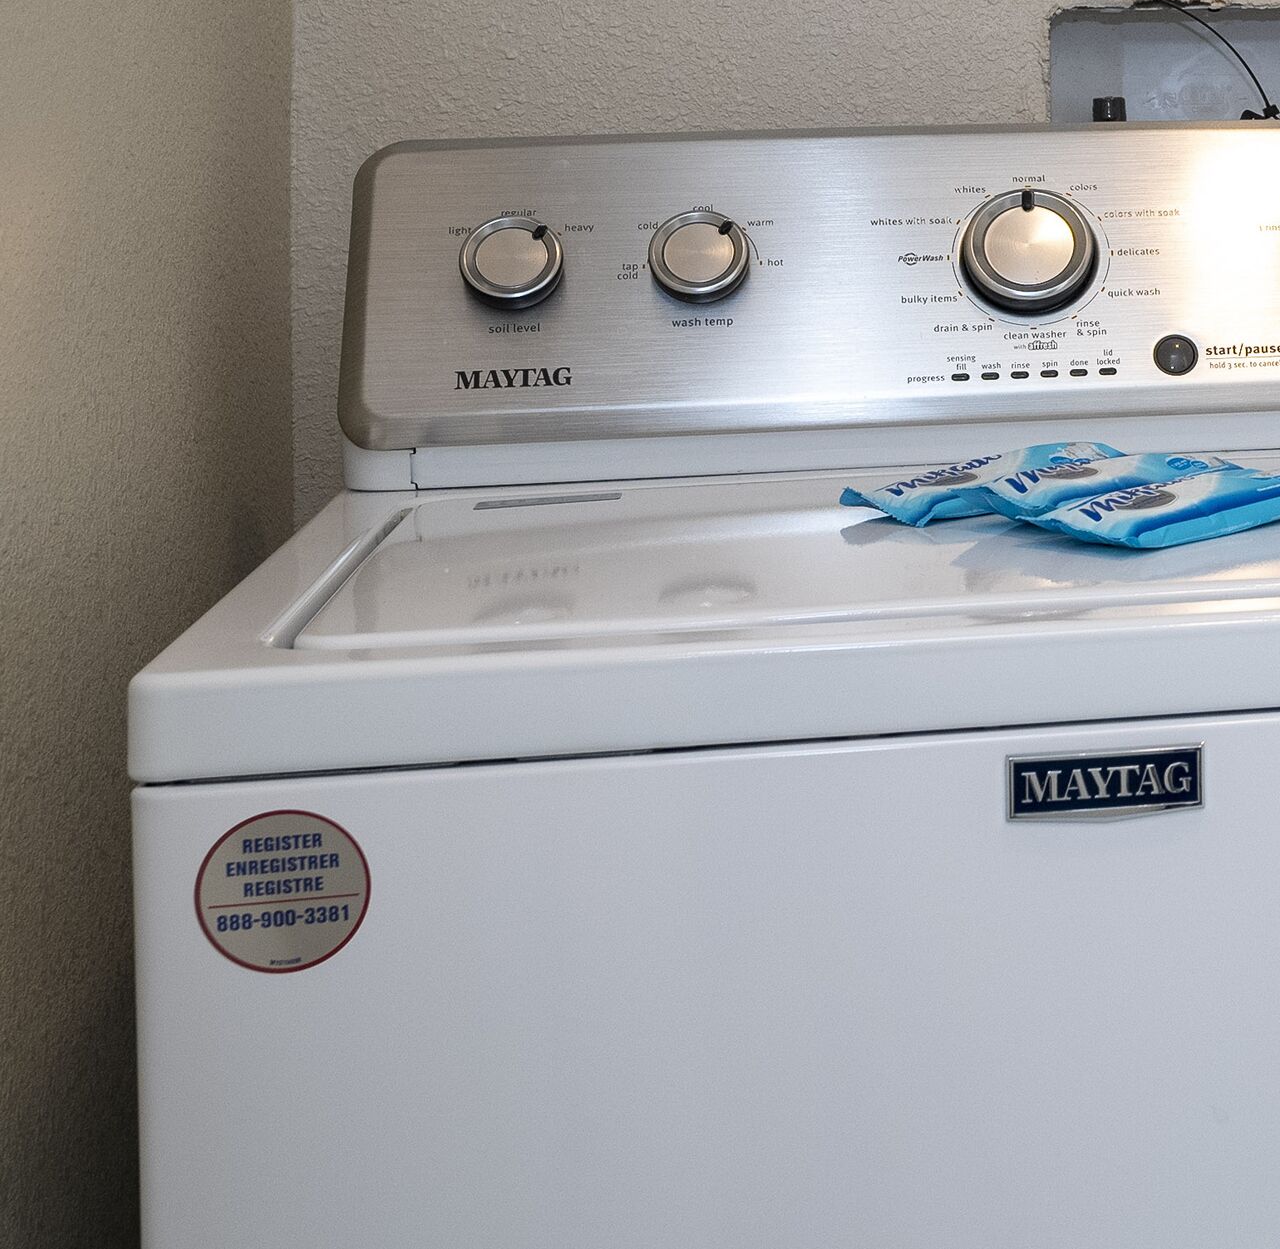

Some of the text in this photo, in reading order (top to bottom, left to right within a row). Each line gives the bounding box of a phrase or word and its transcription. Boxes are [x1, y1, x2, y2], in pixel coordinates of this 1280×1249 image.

[1012, 174, 1046, 184] normal
[954, 185, 987, 194] whites
[1069, 183, 1098, 192] colors
[692, 204, 714, 212] cool
[1104, 208, 1180, 219] colors with soak
[747, 219, 774, 227] warm
[870, 218, 903, 226] whites
[905, 216, 926, 226] with
[448, 226, 472, 236] light
[564, 223, 595, 233] heavy
[637, 222, 659, 231] cold
[1117, 247, 1161, 256] delicates
[767, 258, 784, 267] hot
[898, 254, 944, 263] PowerWash
[622, 263, 639, 272] tap
[617, 272, 639, 281] cold
[1107, 287, 1161, 298] quick wash
[901, 294, 958, 305] bulky items
[671, 317, 734, 328] wash temp
[1076, 319, 1101, 328] rinse
[488, 322, 541, 334] soil level
[933, 323, 993, 333] drain & spin
[1076, 327, 1108, 338] & spin
[1003, 330, 1067, 340] clean washer
[1103, 349, 1113, 357] lid
[946, 354, 977, 364] sensing
[1041, 359, 1059, 369] spin
[1069, 358, 1089, 367] done
[1096, 356, 1121, 366] locked
[956, 362, 968, 371] fill
[981, 361, 1002, 370] wash
[1011, 361, 1031, 370] rinse
[1209, 360, 1226, 370] hold
[1227, 362, 1233, 370] 3
[454, 366, 573, 390] MAYTAG
[907, 373, 946, 384] progress
[1020, 761, 1193, 804] MAYTAG
[242, 833, 322, 854] REGISTER
[226, 853, 340, 877] ENREGISTRER
[243, 876, 325, 898] REGISTRE
[217, 904, 350, 933] 888-900-3381
